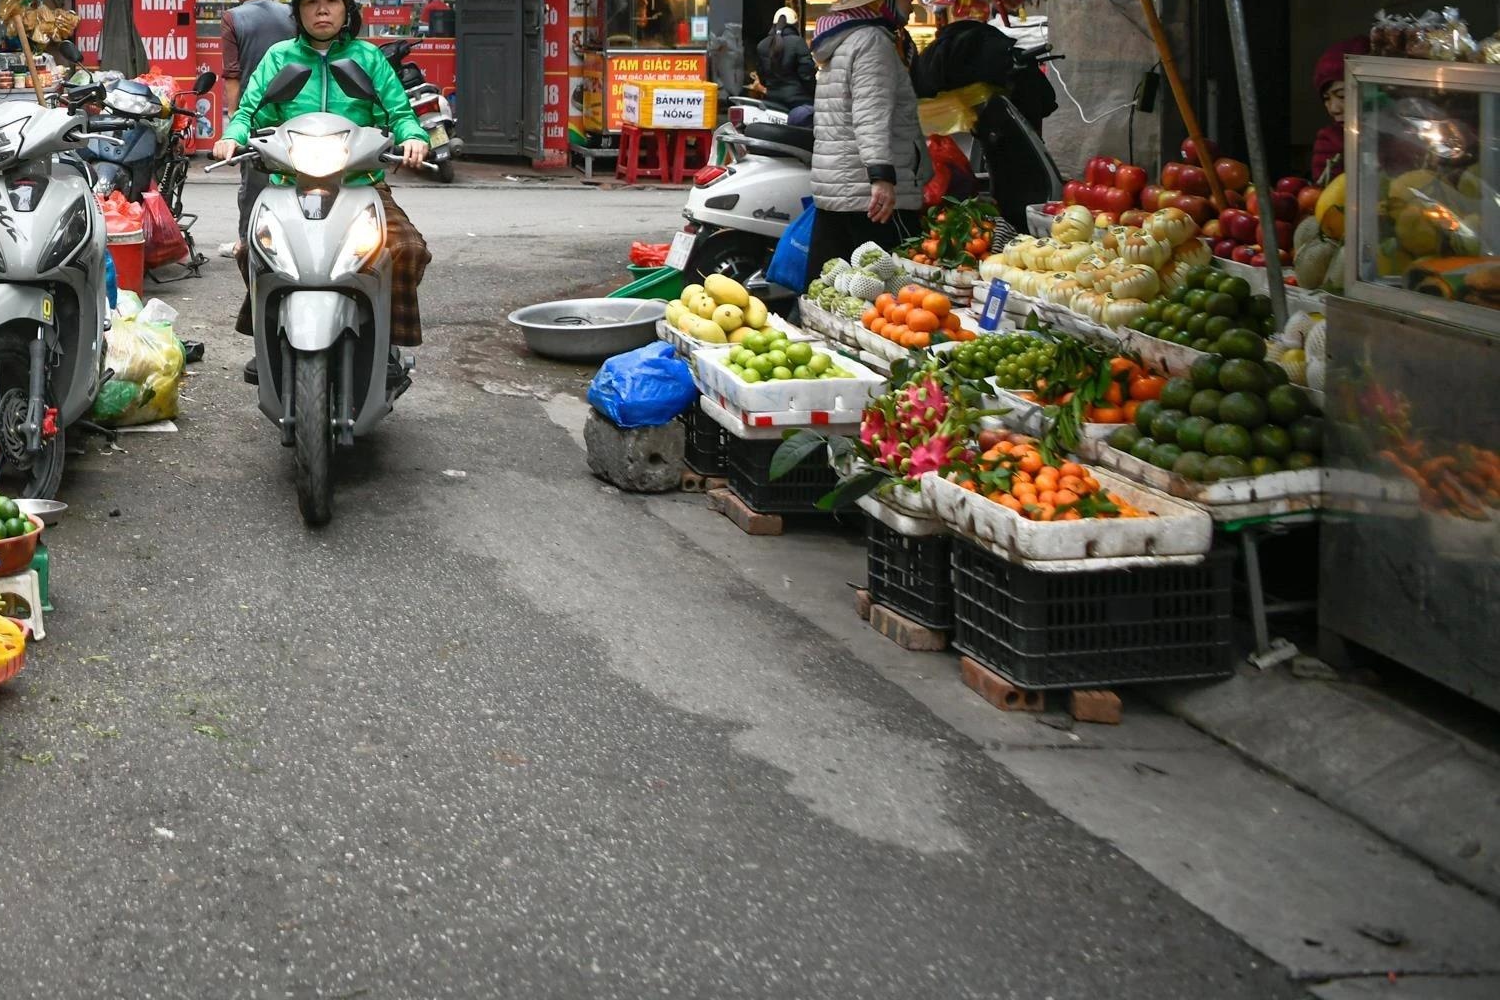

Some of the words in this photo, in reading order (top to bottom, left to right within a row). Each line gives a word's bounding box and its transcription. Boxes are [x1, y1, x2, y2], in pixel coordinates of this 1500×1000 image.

[141, 29, 188, 60] KHẨU
[612, 60, 638, 70] TAM
[643, 58, 671, 71] GIÁC
[675, 60, 698, 70] 25K
[656, 94, 683, 105] BÁNH
[663, 109, 693, 119] NÓNG
